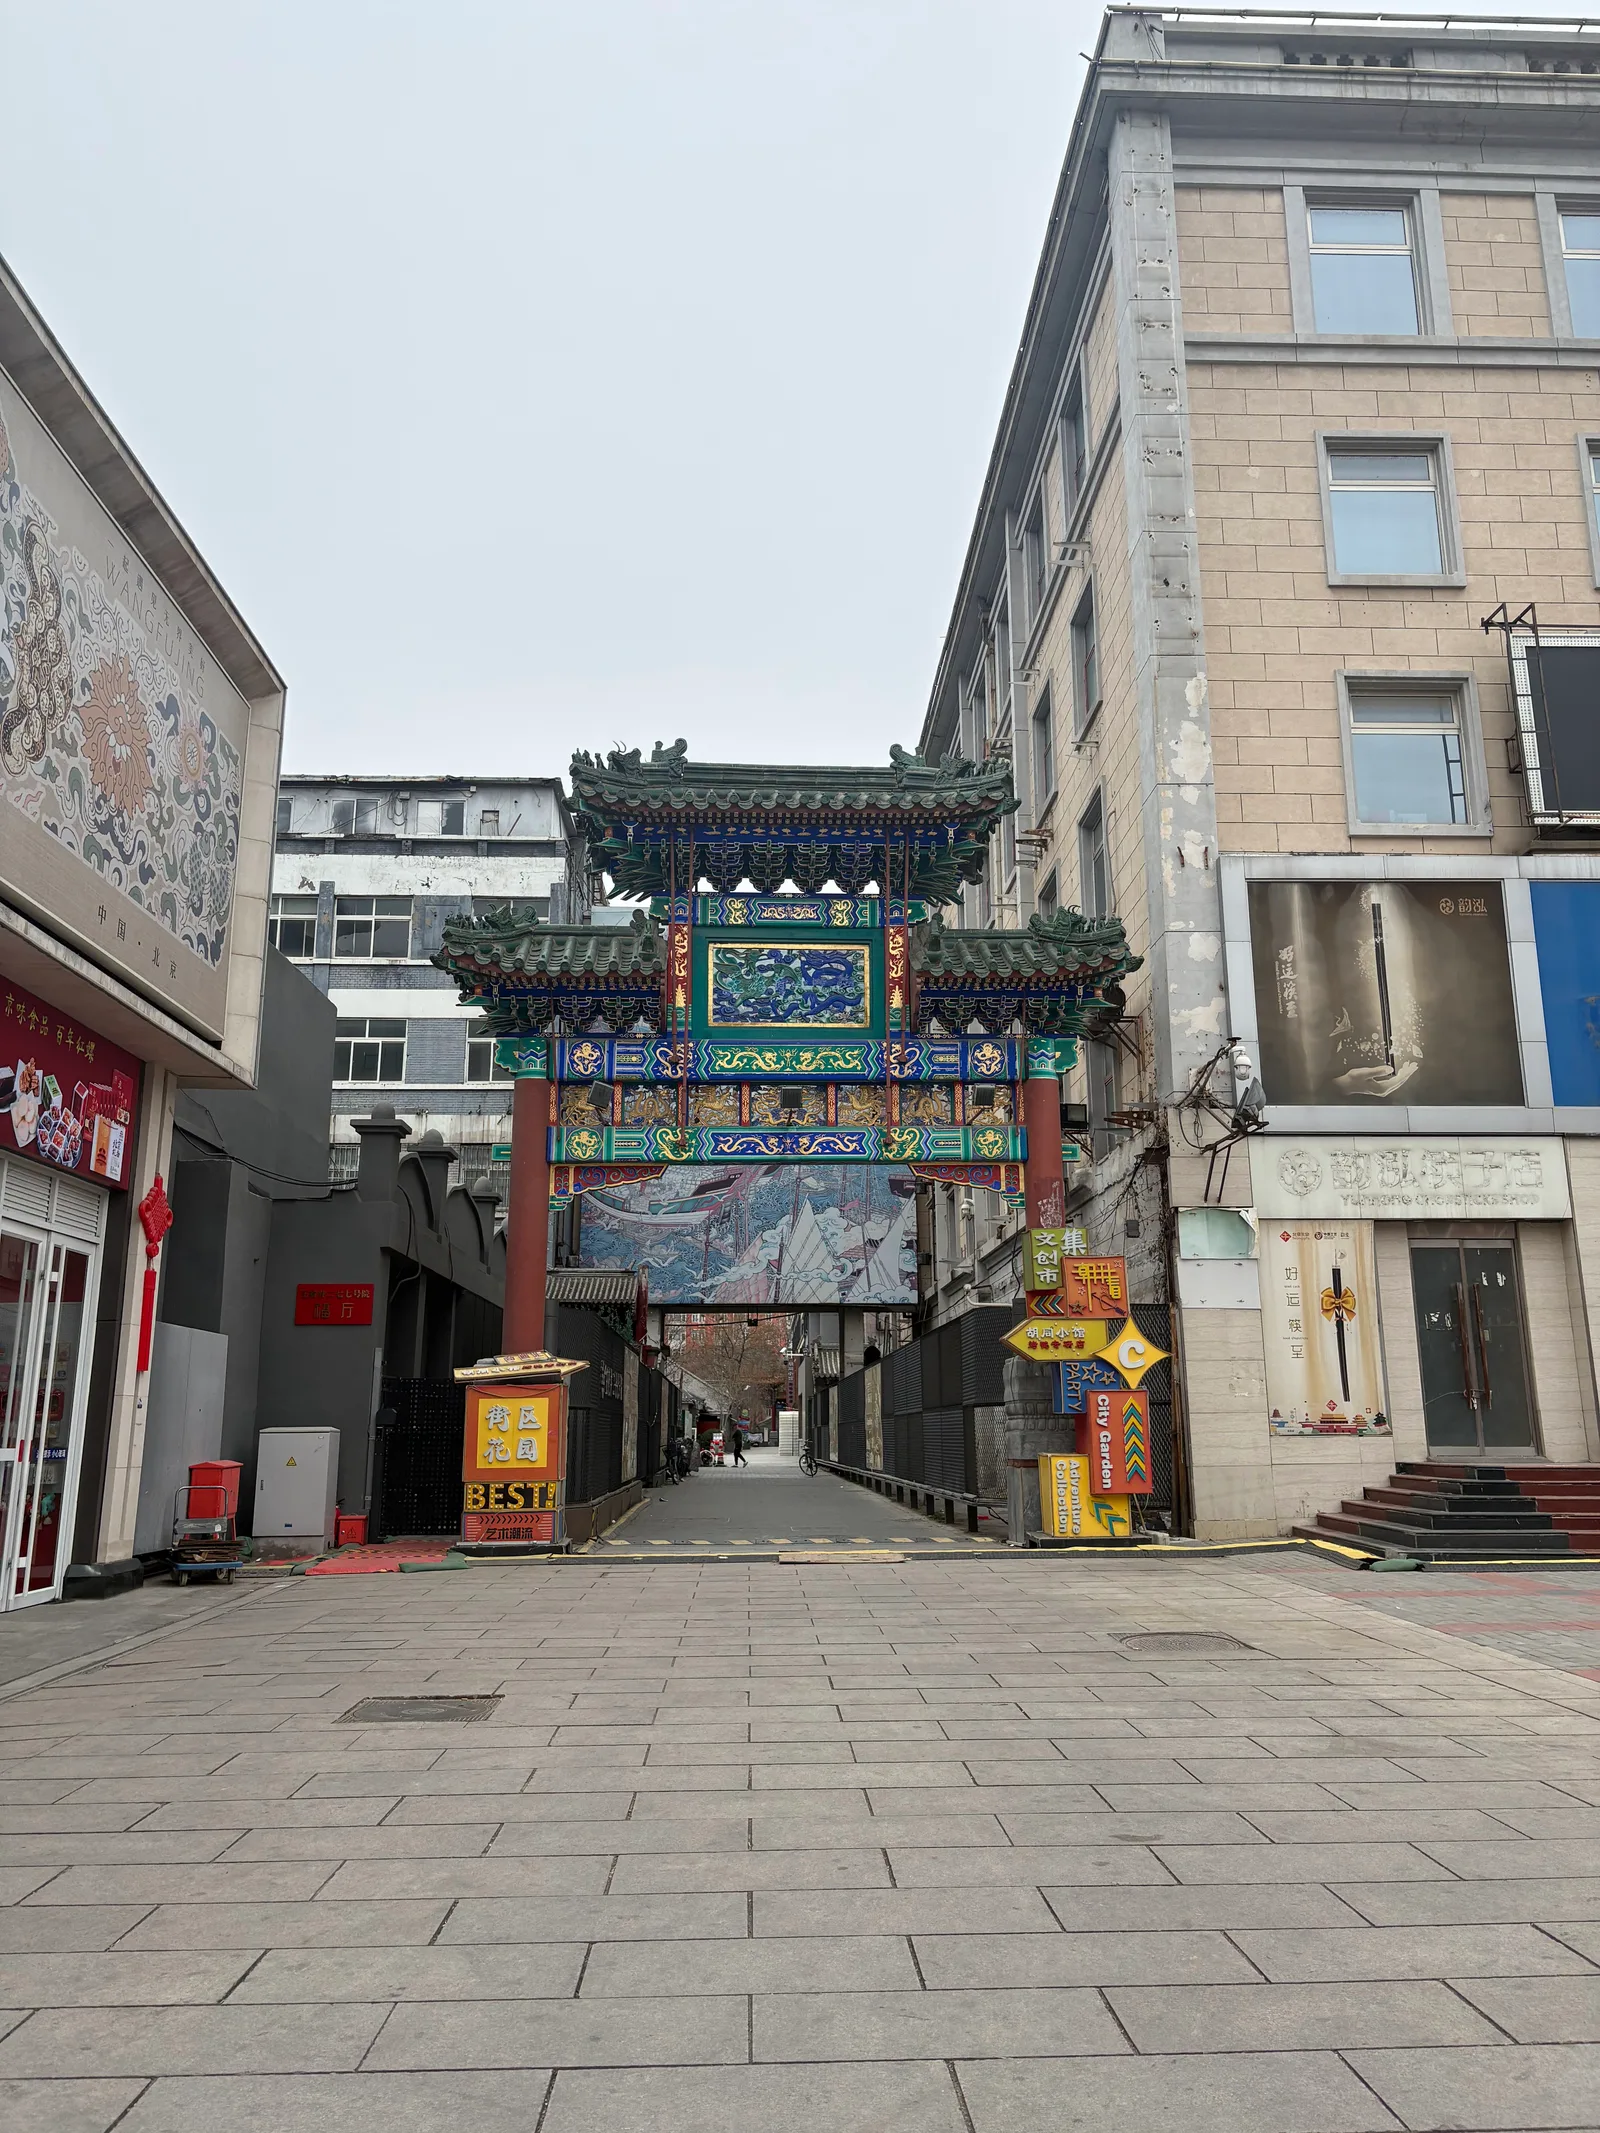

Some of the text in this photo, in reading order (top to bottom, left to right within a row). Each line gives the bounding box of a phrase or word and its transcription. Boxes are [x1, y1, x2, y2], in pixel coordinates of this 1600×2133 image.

[105, 555, 204, 699] WANGFUJING
[1458, 898, 1488, 913] 韵泓
[1278, 945, 1299, 1018] 好运筷至
[1285, 1266, 1304, 1359] 好运筷至
[1118, 1340, 1145, 1369] C
[1065, 1362, 1082, 1412] PARTY
[486, 1404, 542, 1433] 街区
[1097, 1394, 1113, 1489] City Garden
[483, 1437, 539, 1464] 花园
[466, 1482, 556, 1511] BEST!
[1056, 1460, 1068, 1533] Collection
[1069, 1460, 1081, 1534] Adventure
[486, 1526, 534, 1540] 艺术潮流
